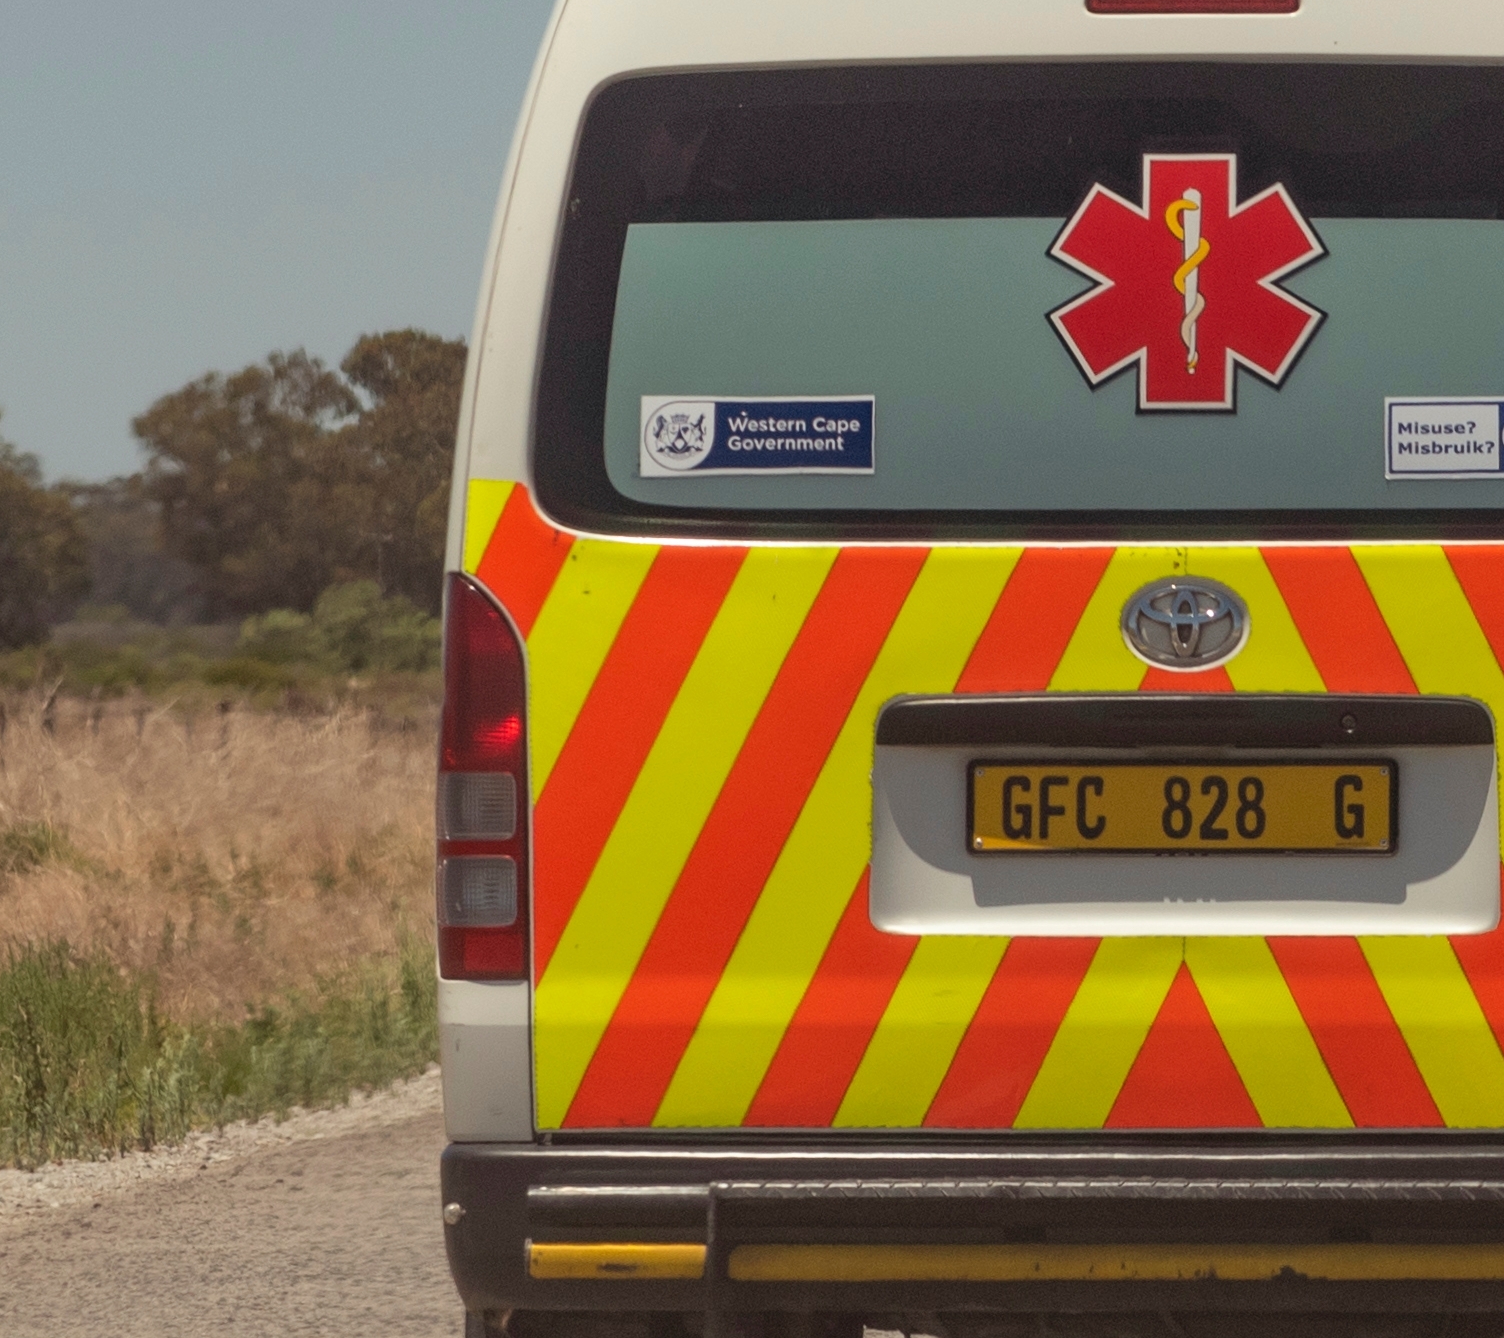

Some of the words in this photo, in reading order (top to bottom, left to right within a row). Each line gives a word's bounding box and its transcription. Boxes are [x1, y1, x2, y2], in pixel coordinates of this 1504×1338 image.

[727, 416, 807, 433] Western
[812, 417, 861, 435] Cape
[1397, 421, 1476, 436] Misuse?
[727, 435, 845, 452] Government
[1397, 440, 1495, 456] Misbruik?
[1002, 774, 1106, 840] GFC
[1161, 775, 1267, 841] 828
[1333, 773, 1365, 840] G
